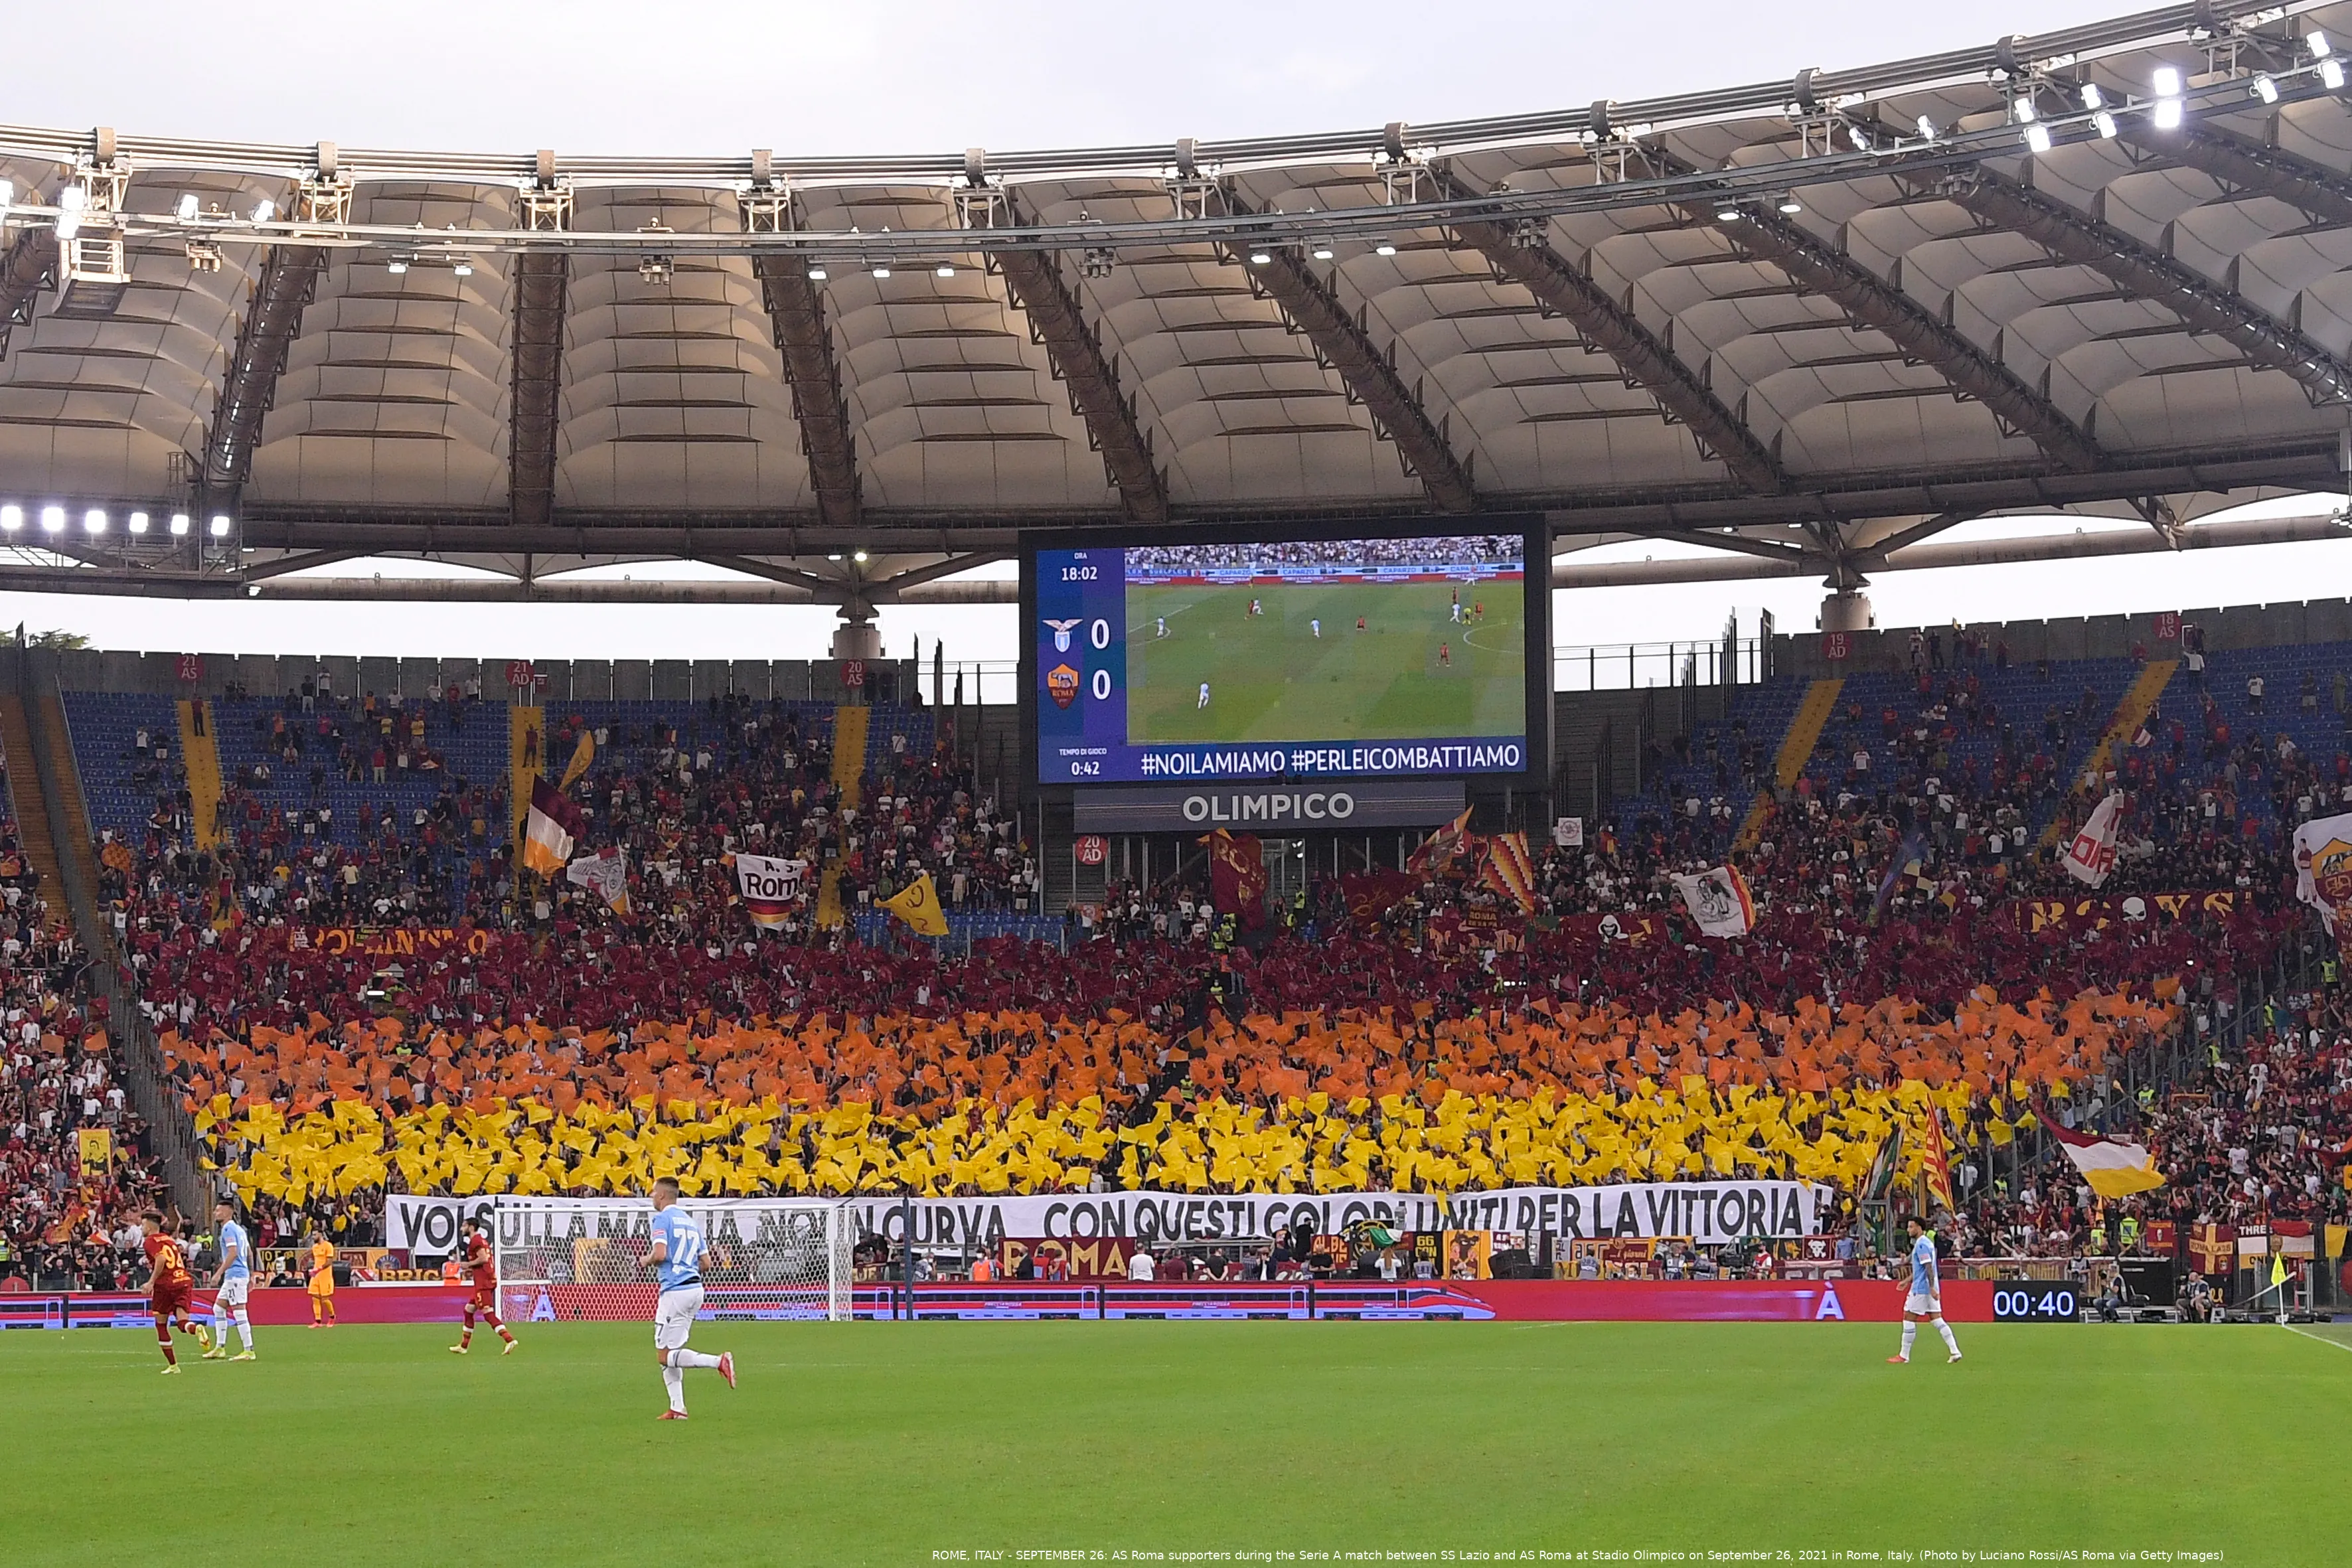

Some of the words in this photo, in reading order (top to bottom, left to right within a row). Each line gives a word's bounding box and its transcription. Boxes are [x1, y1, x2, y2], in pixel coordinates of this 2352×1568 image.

[1061, 566, 1097, 581] 18:02
[2160, 613, 2174, 625] 18
[1091, 619, 1109, 649] 0
[2159, 625, 2175, 638] AS
[1830, 633, 1844, 645] 19
[1828, 647, 1845, 658] AD
[182, 655, 195, 666] 21
[514, 661, 526, 672] 21
[848, 661, 862, 672] 20
[181, 667, 197, 679] AS
[512, 674, 529, 685] AD
[847, 674, 863, 685] AS
[1092, 669, 1111, 700] 0
[1140, 750, 1285, 775] #NOILAMIAMO
[1291, 744, 1520, 771] #PERLEICOMBATTIAMO
[1071, 761, 1100, 775] 0:42
[1182, 792, 1354, 822] OLIMPICO
[1084, 835, 1100, 848] 20
[1082, 848, 1102, 862] AD
[1044, 1199, 1126, 1237] CON
[1134, 1198, 1254, 1241] QUESTI
[1593, 1192, 1640, 1237] LA
[673, 1228, 699, 1265] 77
[1417, 1235, 1435, 1246] 66
[1994, 1291, 2074, 1317] 00:40
